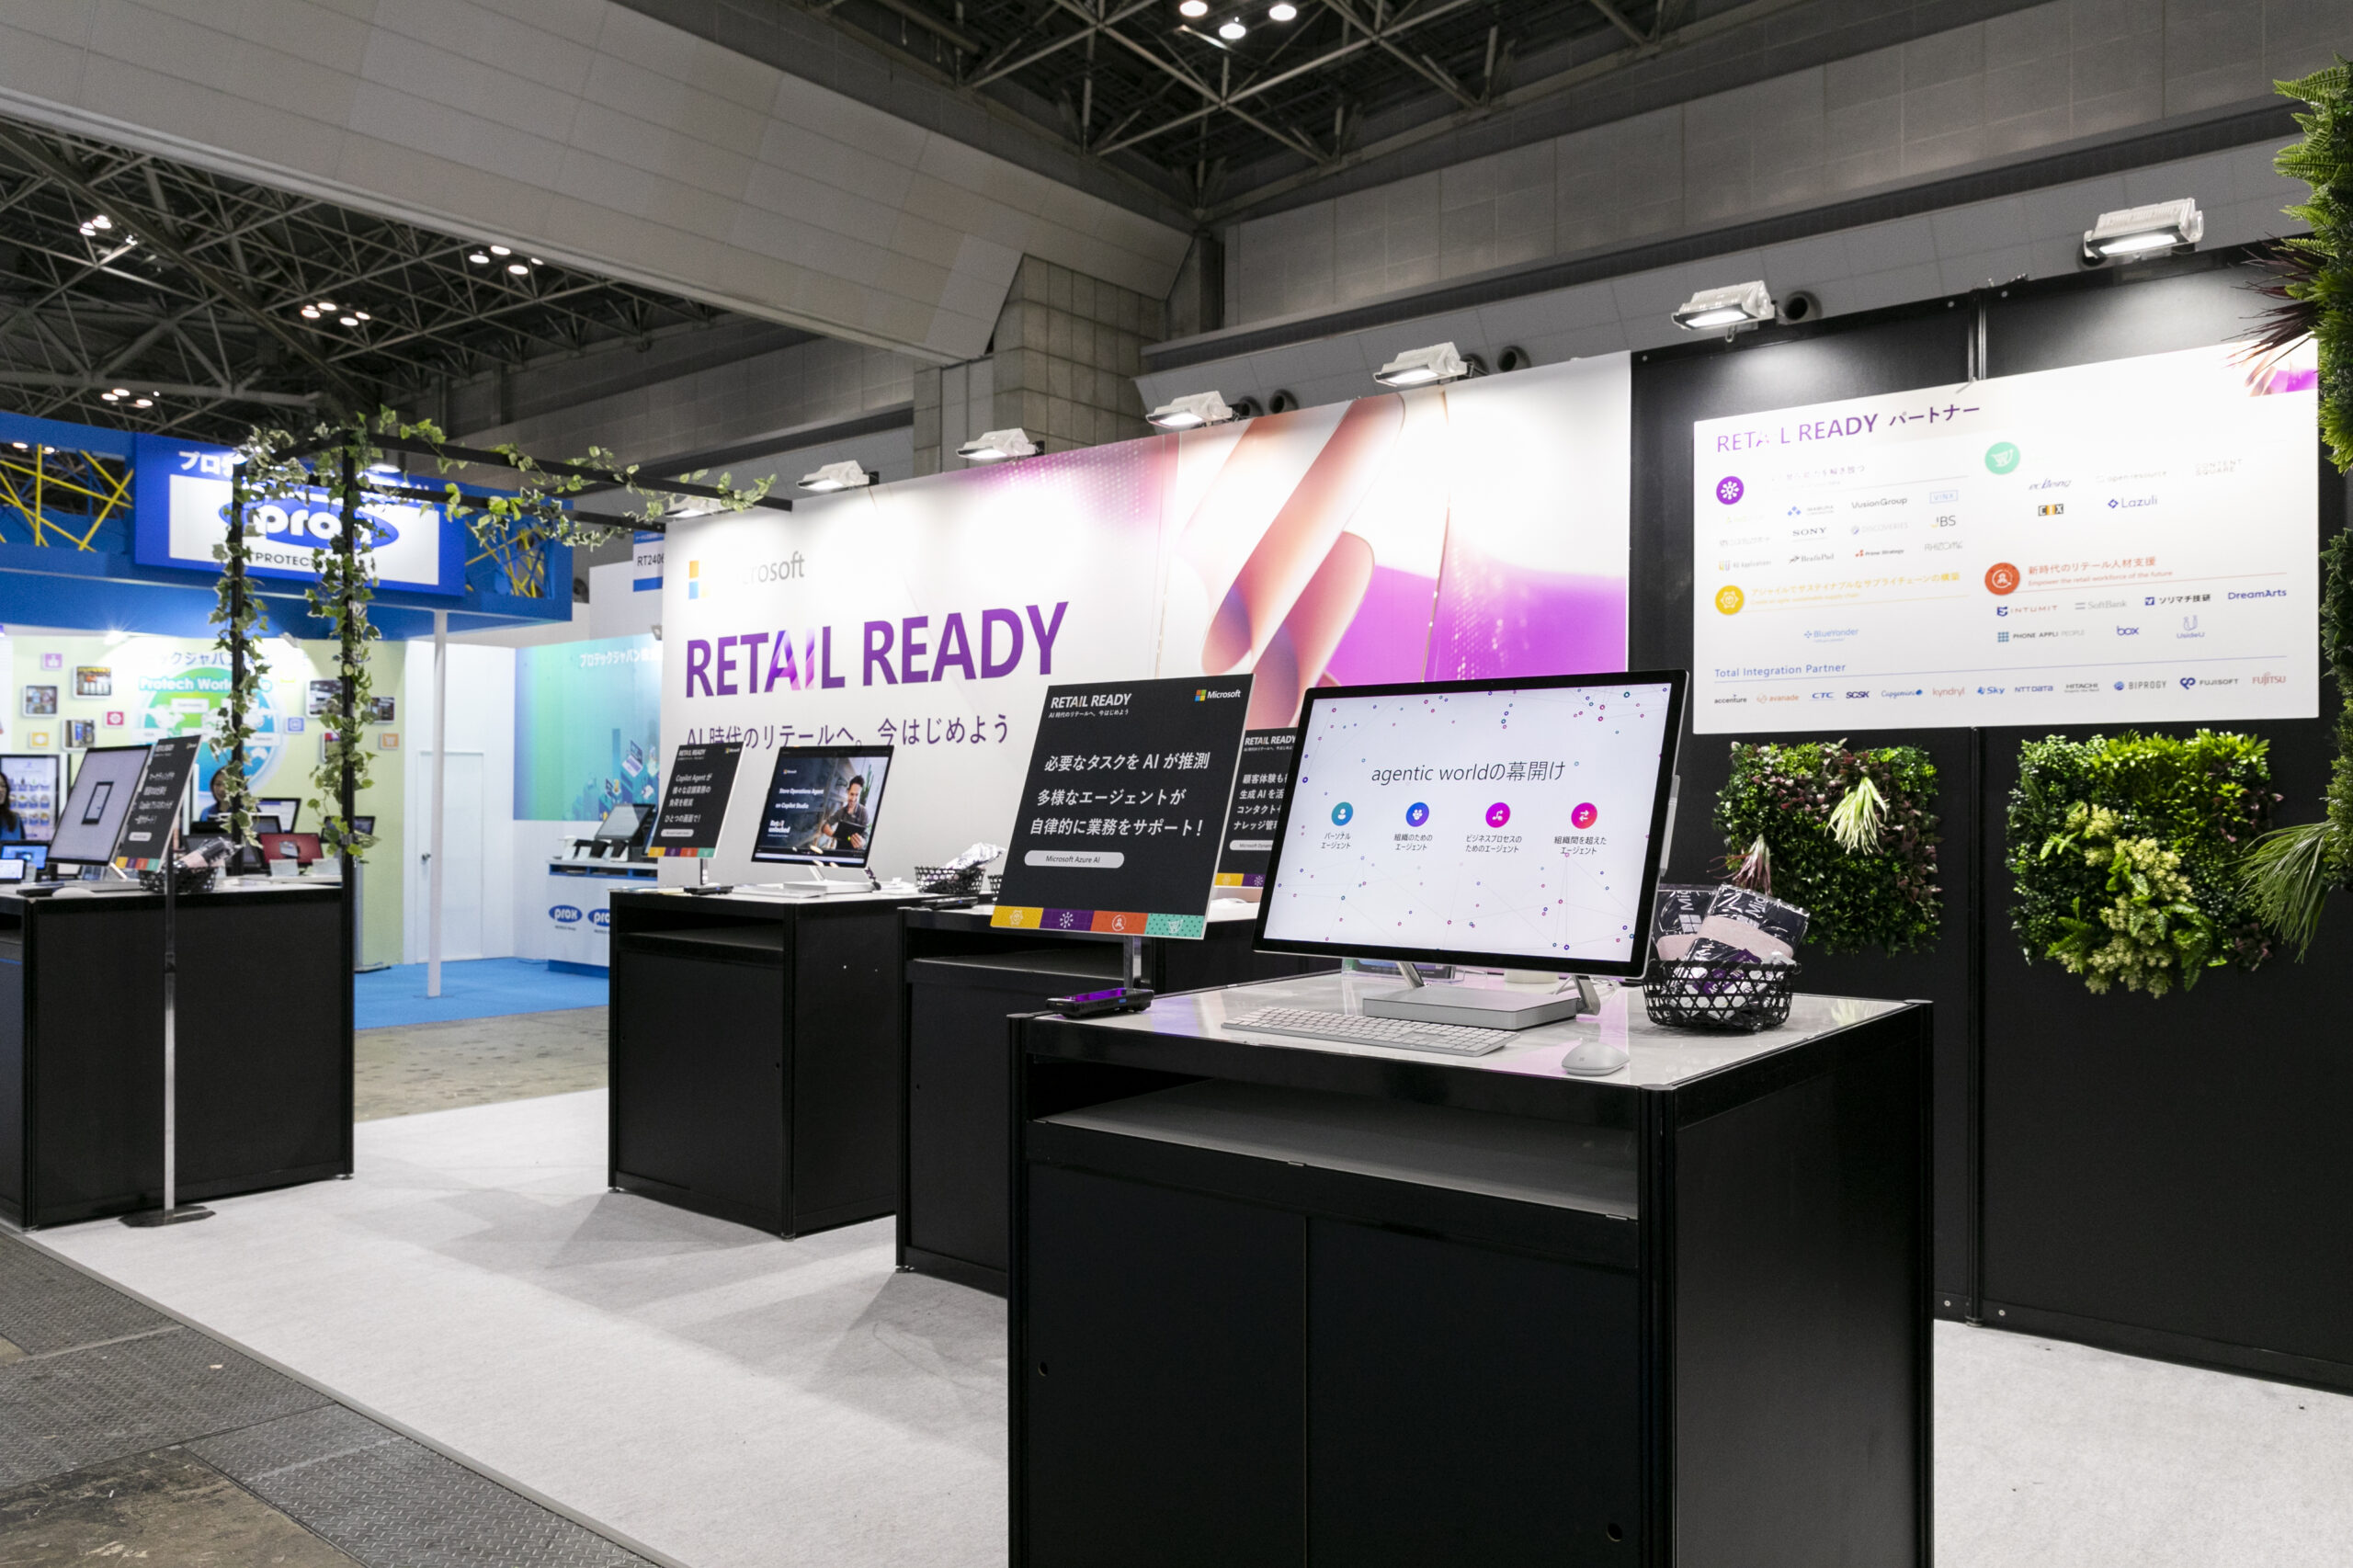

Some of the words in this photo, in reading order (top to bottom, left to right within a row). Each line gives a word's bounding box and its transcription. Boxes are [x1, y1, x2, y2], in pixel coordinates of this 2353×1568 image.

[1717, 427, 1790, 453] RETAL
[1799, 414, 1878, 442] READY
[1889, 404, 1980, 426] パートナー
[2121, 495, 2158, 508] Lazuli
[253, 505, 371, 546] pro
[1792, 527, 1826, 537] SONY
[255, 552, 315, 567] PROTEC
[2228, 588, 2287, 600] DreamArts
[2088, 600, 2127, 610] SoftBank
[2117, 625, 2140, 636] box
[686, 625, 846, 699] RETAIL
[863, 602, 1069, 687] READY
[1715, 668, 1740, 677] Total
[1743, 665, 1802, 678] Integration
[1805, 663, 1846, 674] Partner
[2129, 680, 2166, 689] BIPROGY
[2252, 673, 2286, 686] FUJITSU
[1207, 689, 1241, 699] Microsoft
[1846, 691, 1870, 699] SCSK
[1932, 687, 1965, 698] kyndryl
[1987, 686, 2005, 694] Sky
[1051, 696, 1088, 709] RETAIL
[1091, 693, 1132, 707] READY
[1714, 694, 1747, 704] accenture
[1768, 694, 1800, 702] avanade
[1245, 736, 1269, 746] RETAIL
[1271, 735, 1297, 744] READY
[1044, 754, 1140, 772] 必要なタスクを
[1142, 754, 1159, 769] AI
[1163, 751, 1211, 770] が推測
[1243, 773, 1288, 784] 顧客体験も
[1371, 765, 1434, 786] agentic
[1439, 761, 1565, 782] worldの幕開け
[1038, 789, 1187, 806] 多様なエージェントが
[1029, 817, 1203, 836] 自律的に業務をサポート！
[1324, 832, 1352, 840] パーソナル
[1393, 833, 1433, 842] 組織のための
[1466, 835, 1522, 844] ビジネスプロセスの
[1394, 843, 1427, 851] エージェント
[1465, 845, 1519, 854] ためのエージェント
[1560, 846, 1597, 856] エージェント
[1046, 855, 1074, 863] Microsoft
[1074, 855, 1093, 863] Azure
